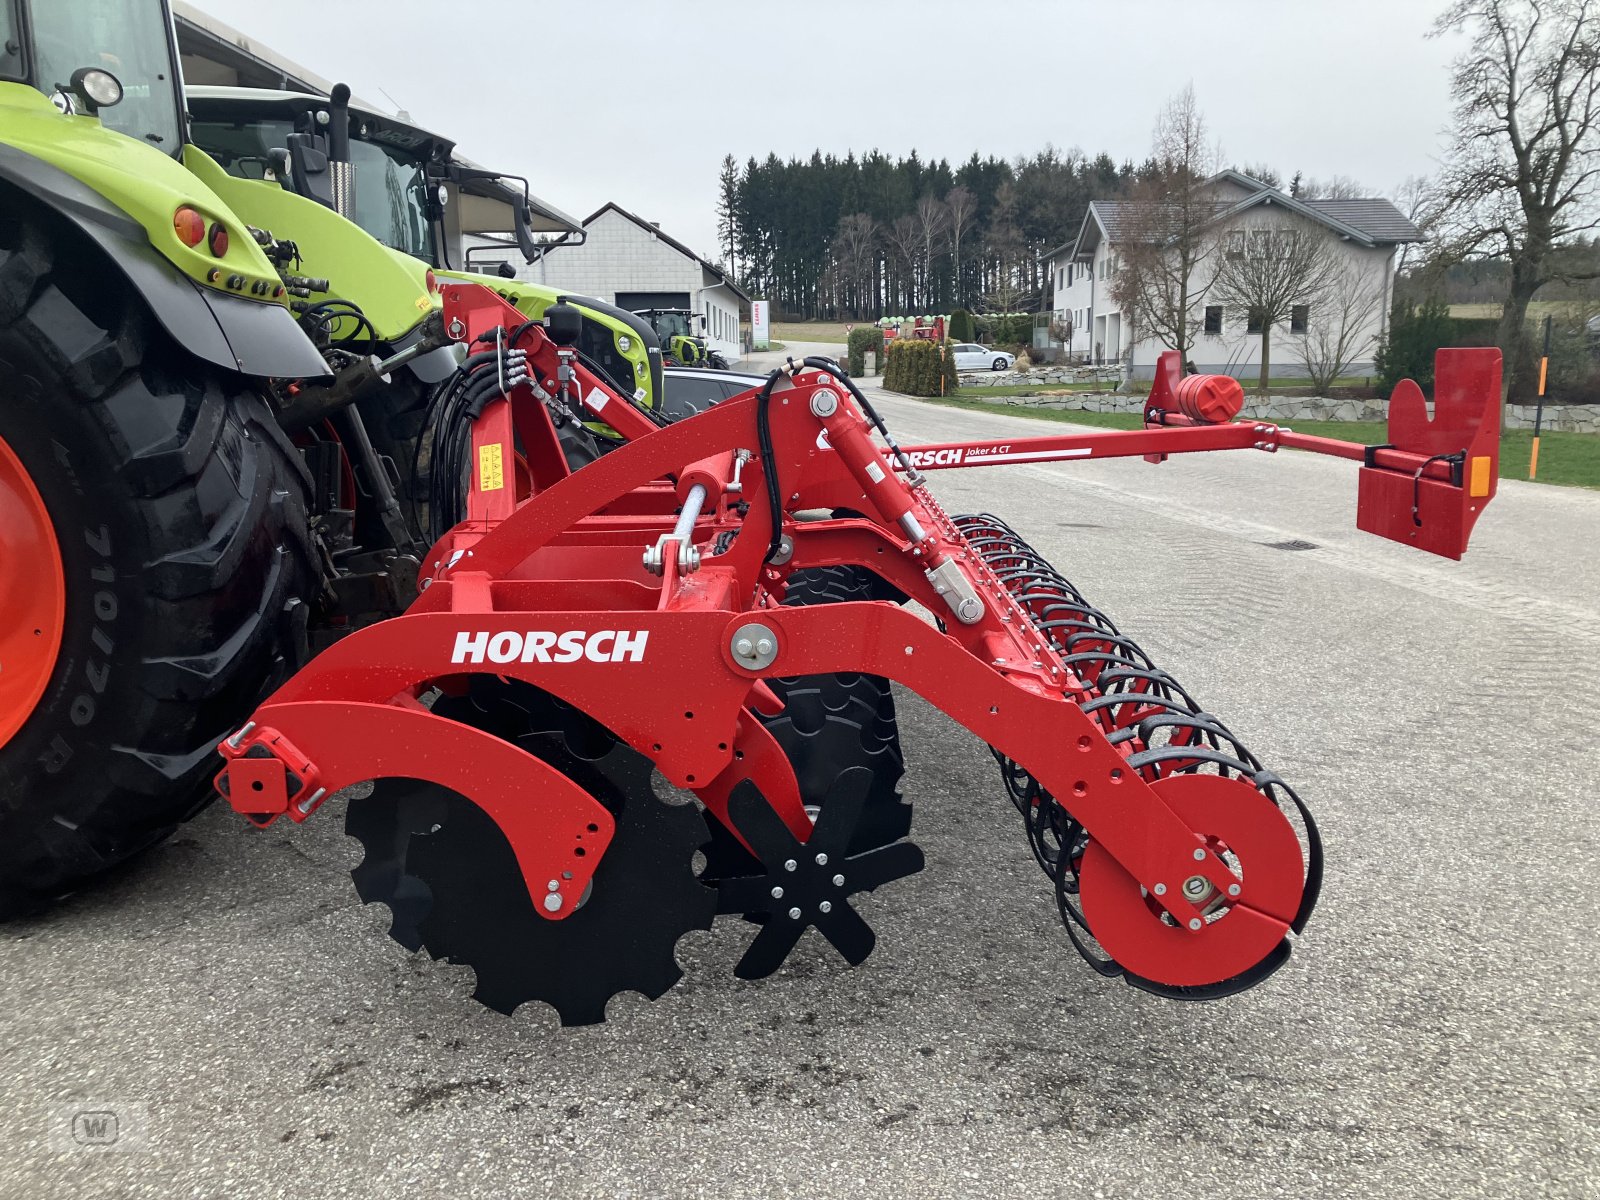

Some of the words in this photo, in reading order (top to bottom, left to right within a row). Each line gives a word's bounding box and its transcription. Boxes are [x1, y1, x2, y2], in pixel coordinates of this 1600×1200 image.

[966, 447, 989, 456] Joker
[991, 446, 997, 454] 4
[999, 445, 1012, 454] CT
[71, 524, 118, 727] 710/70
[451, 630, 649, 664] HORSCH
